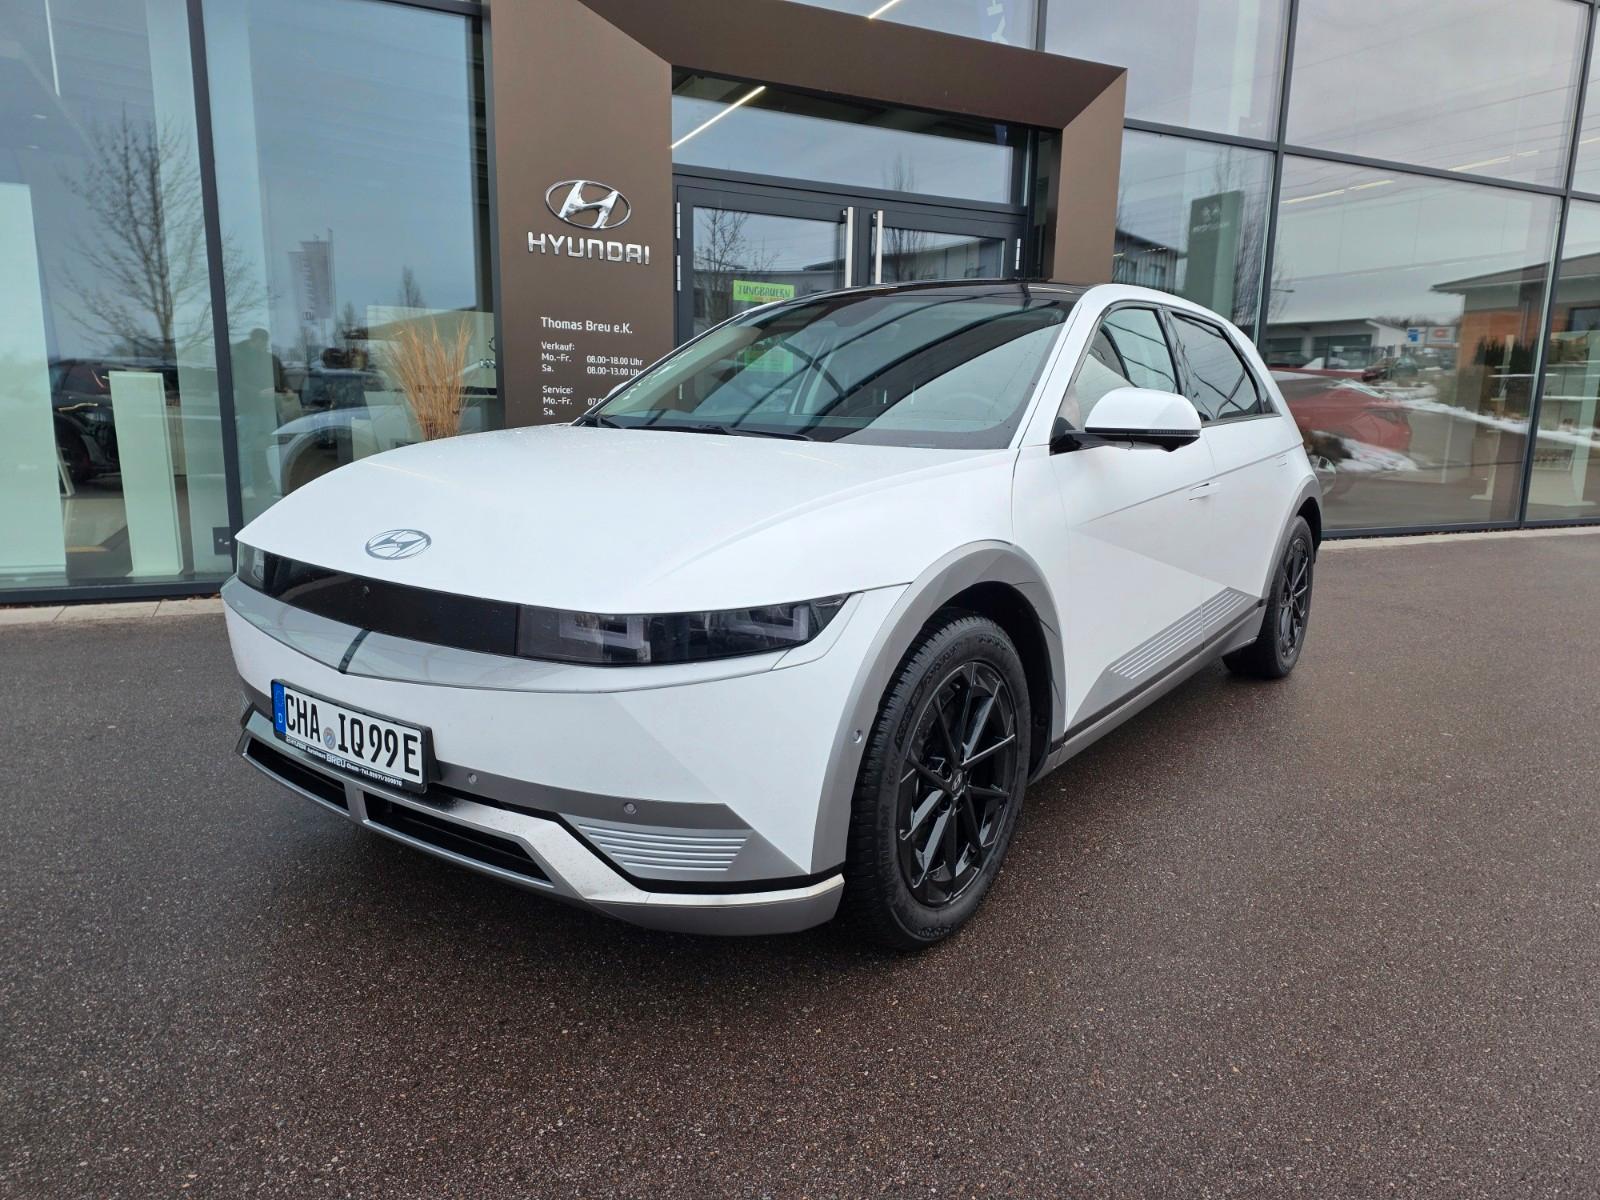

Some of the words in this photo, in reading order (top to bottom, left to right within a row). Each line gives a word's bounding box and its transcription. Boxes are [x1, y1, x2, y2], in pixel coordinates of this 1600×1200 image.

[527, 231, 650, 265] HYUNDAI
[540, 316, 583, 330] Thomas
[585, 320, 611, 332] Breu
[613, 322, 633, 334] e.K.
[541, 341, 575, 351] Verkauf:
[541, 353, 572, 362] Mo.-Fr.
[586, 355, 629, 365] 08.00-18.00
[629, 357, 643, 366] Uhr
[541, 364, 554, 372] Sa.
[586, 366, 629, 376] 08.00-13.00
[542, 386, 573, 394] Service:
[542, 397, 573, 405] Mo.-Fr.
[543, 408, 556, 416] Sa.
[278, 712, 283, 724] D
[286, 694, 321, 743] CHA
[326, 753, 346, 769] BREU
